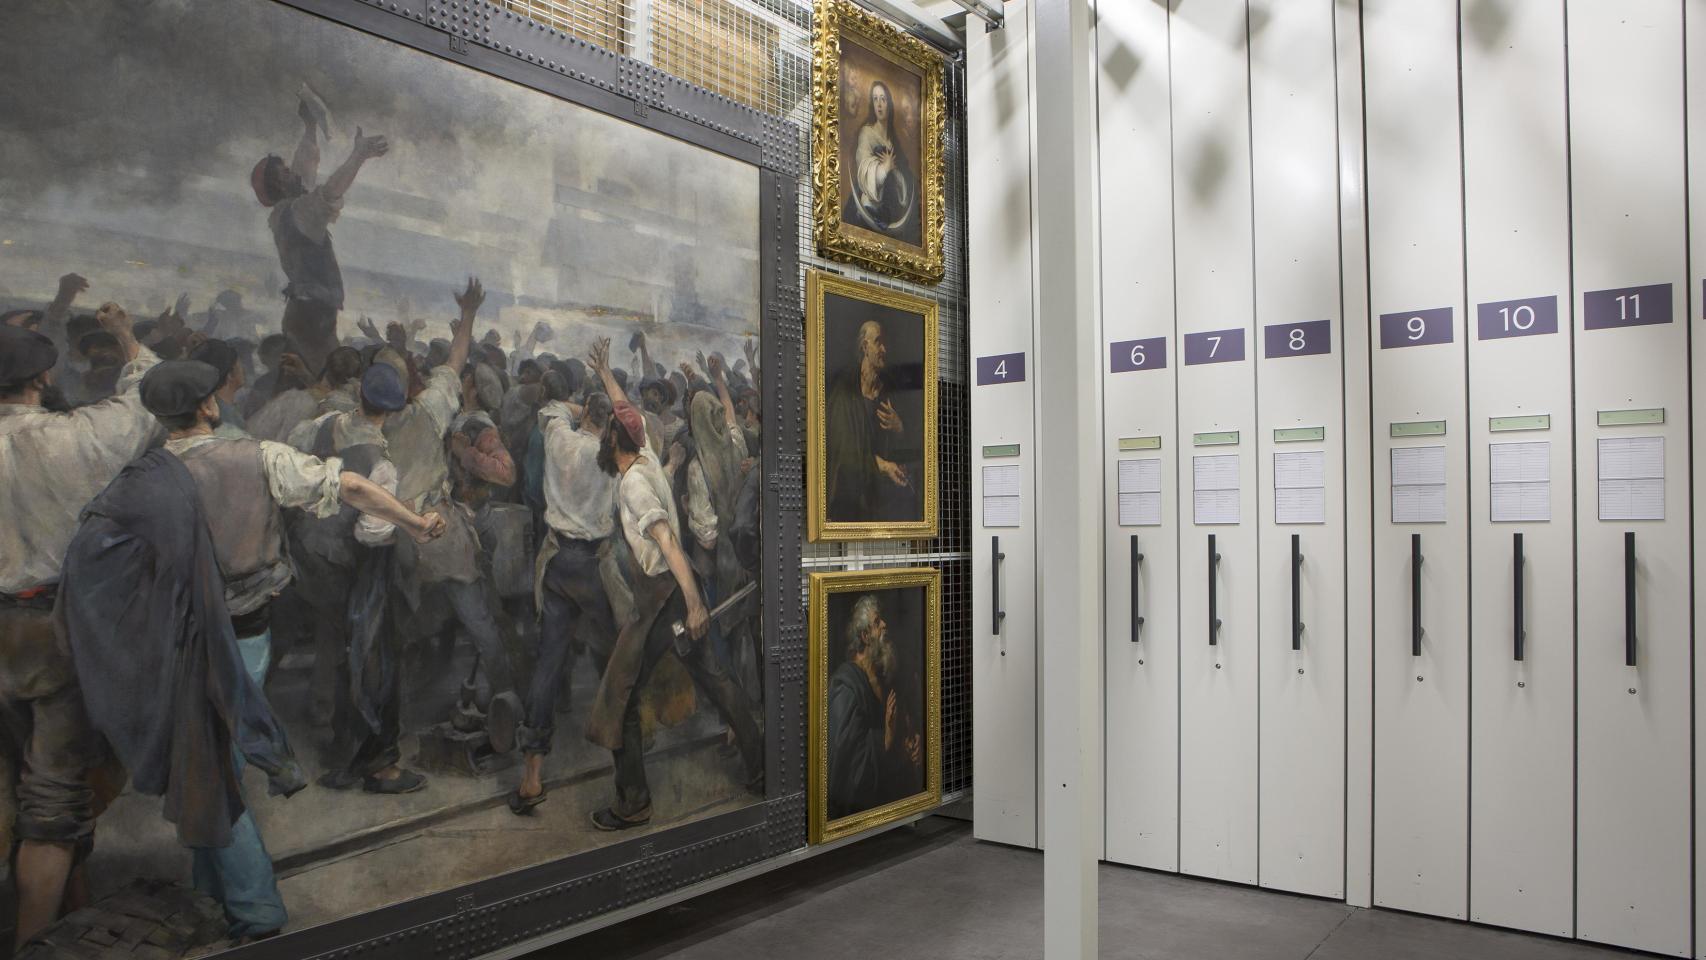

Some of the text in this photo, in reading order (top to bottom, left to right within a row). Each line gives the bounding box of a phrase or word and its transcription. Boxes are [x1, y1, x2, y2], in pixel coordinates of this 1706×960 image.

[1615, 293, 1641, 320] 11
[1406, 316, 1426, 341] 9
[1498, 305, 1536, 332] 10
[1206, 336, 1222, 358] 7
[1288, 328, 1306, 351] 8
[1130, 345, 1146, 366] 6
[993, 359, 1008, 379] 4
